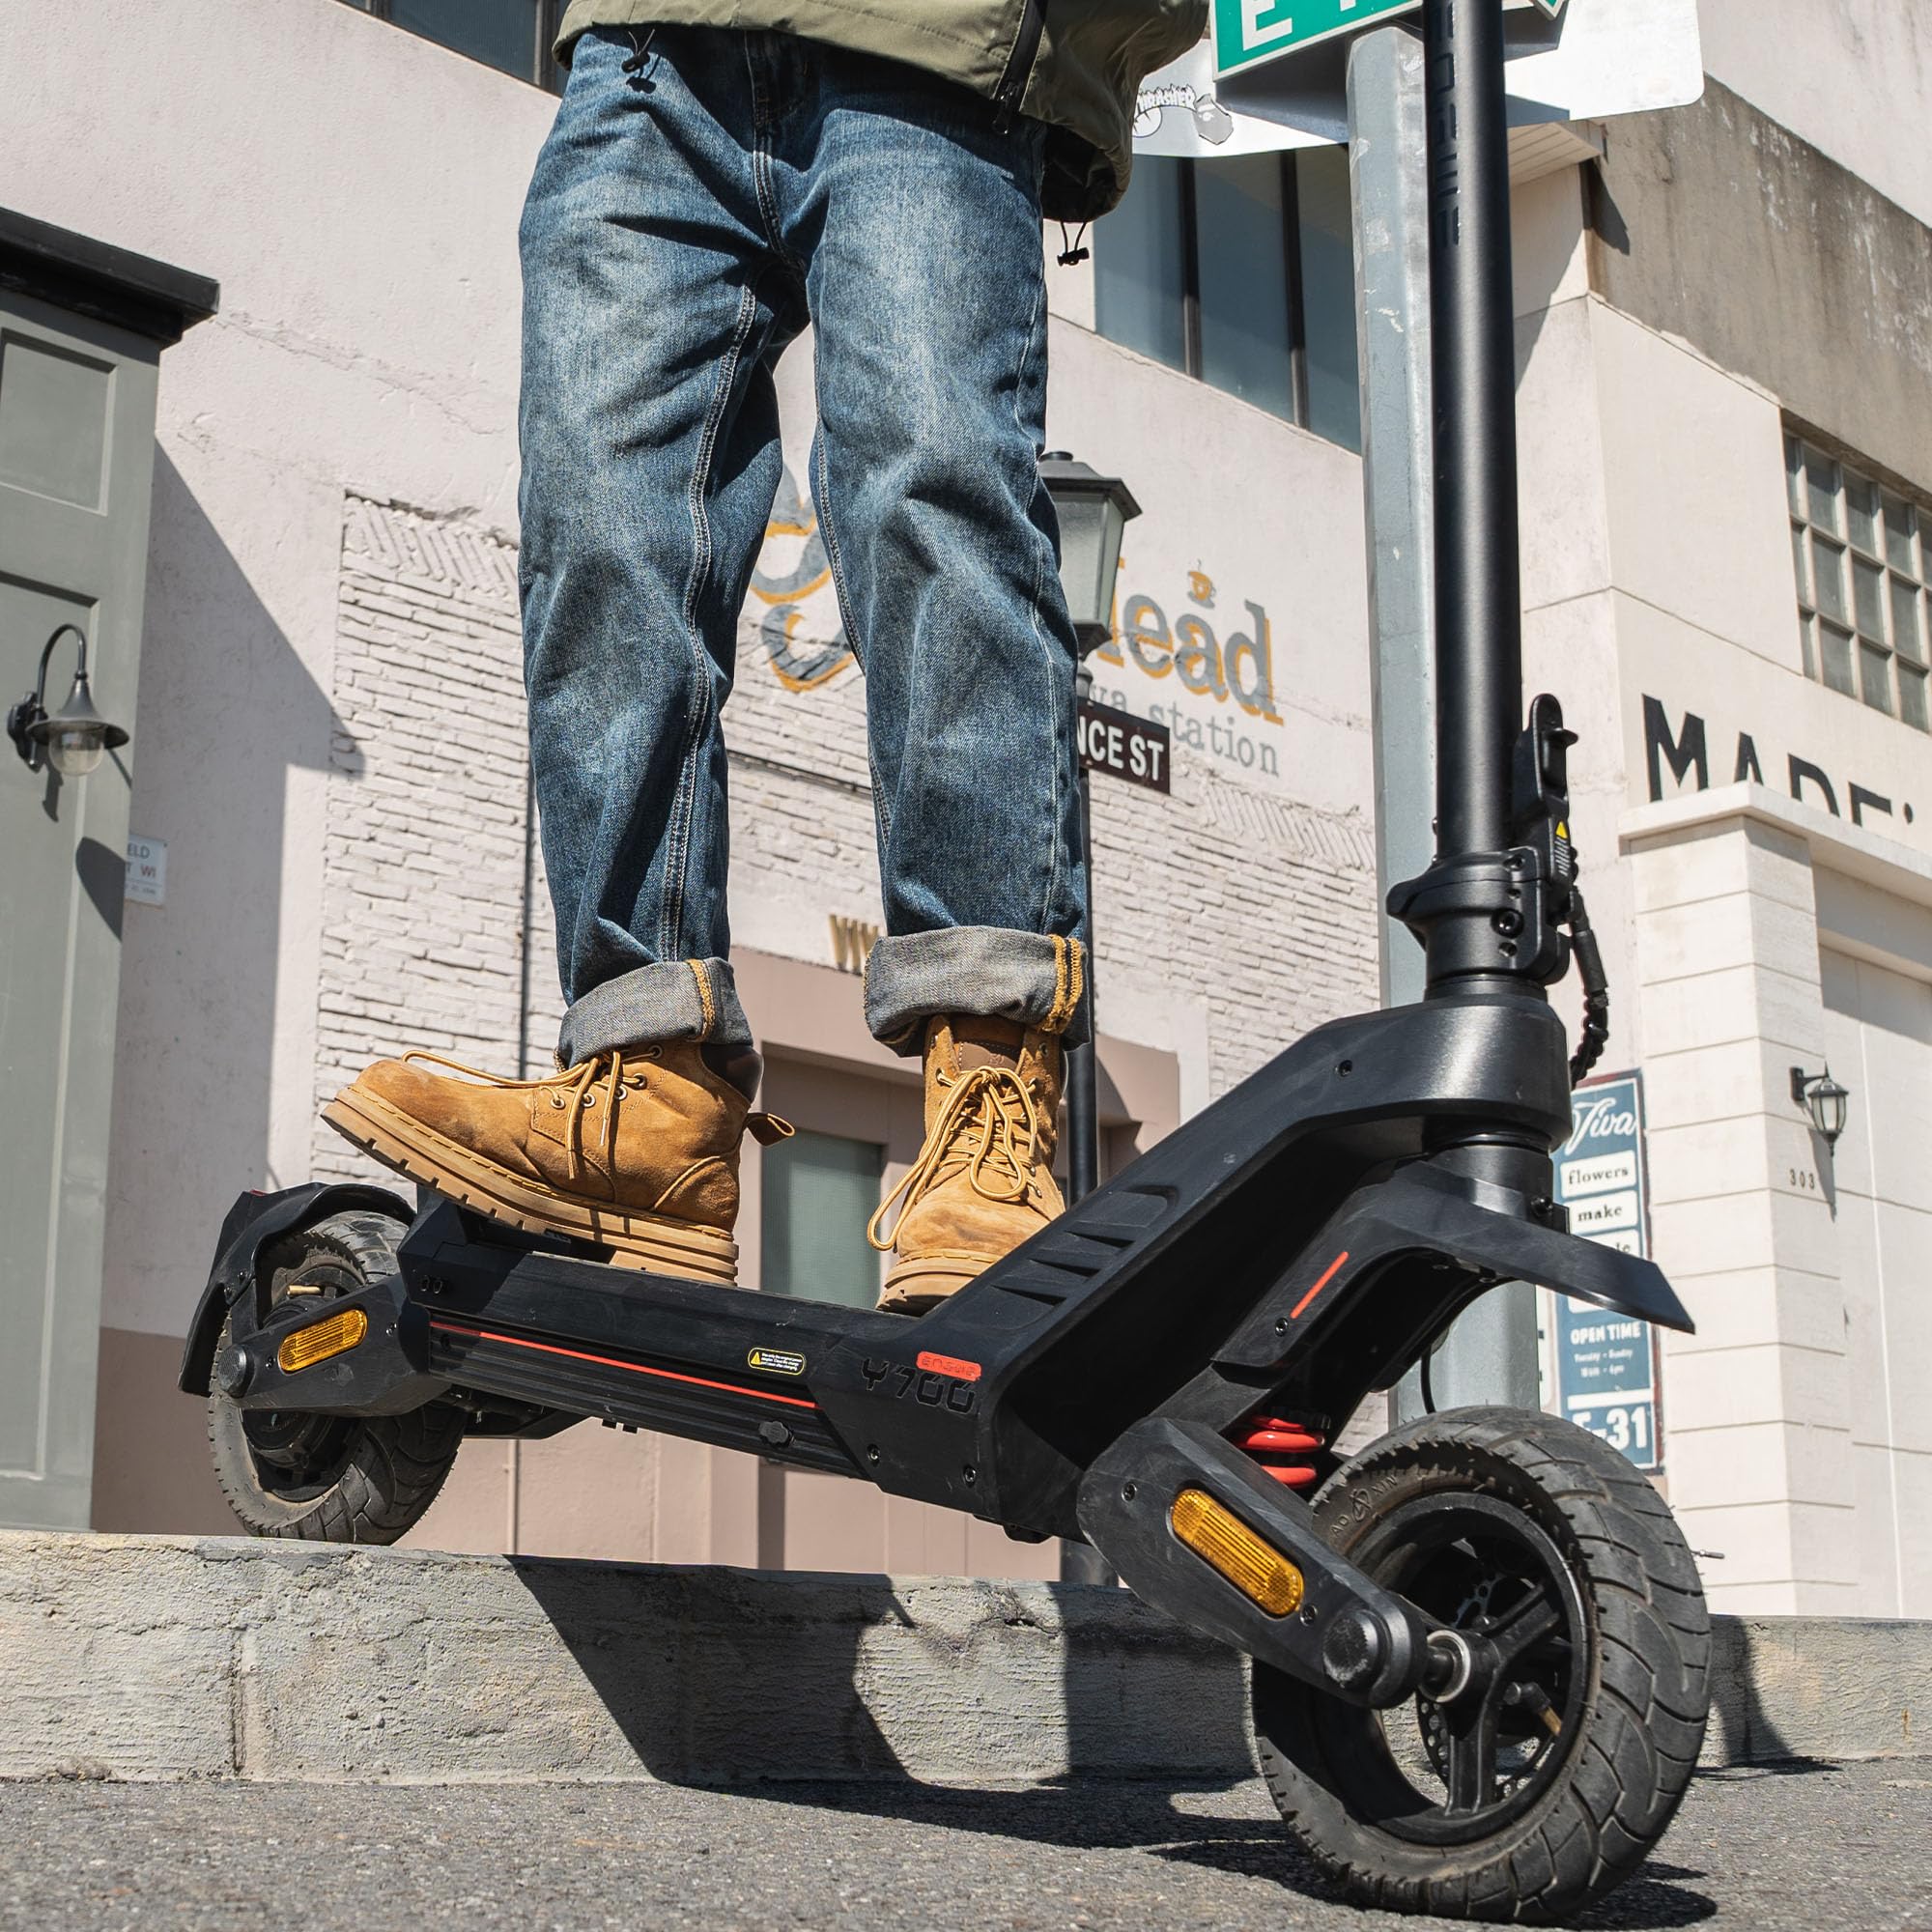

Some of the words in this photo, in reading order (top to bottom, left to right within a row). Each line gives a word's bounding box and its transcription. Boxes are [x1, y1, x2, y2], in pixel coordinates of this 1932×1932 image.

[1136, 83, 1197, 114] HRASHER
[1149, 700, 1279, 778] station
[1129, 734, 1164, 781] ST
[1568, 1167, 1629, 1185] flowers
[1789, 1168, 1815, 1190] 303
[1577, 1204, 1623, 1221] make
[1571, 1324, 1605, 1345] OPEN
[1606, 1321, 1641, 1341] TIME
